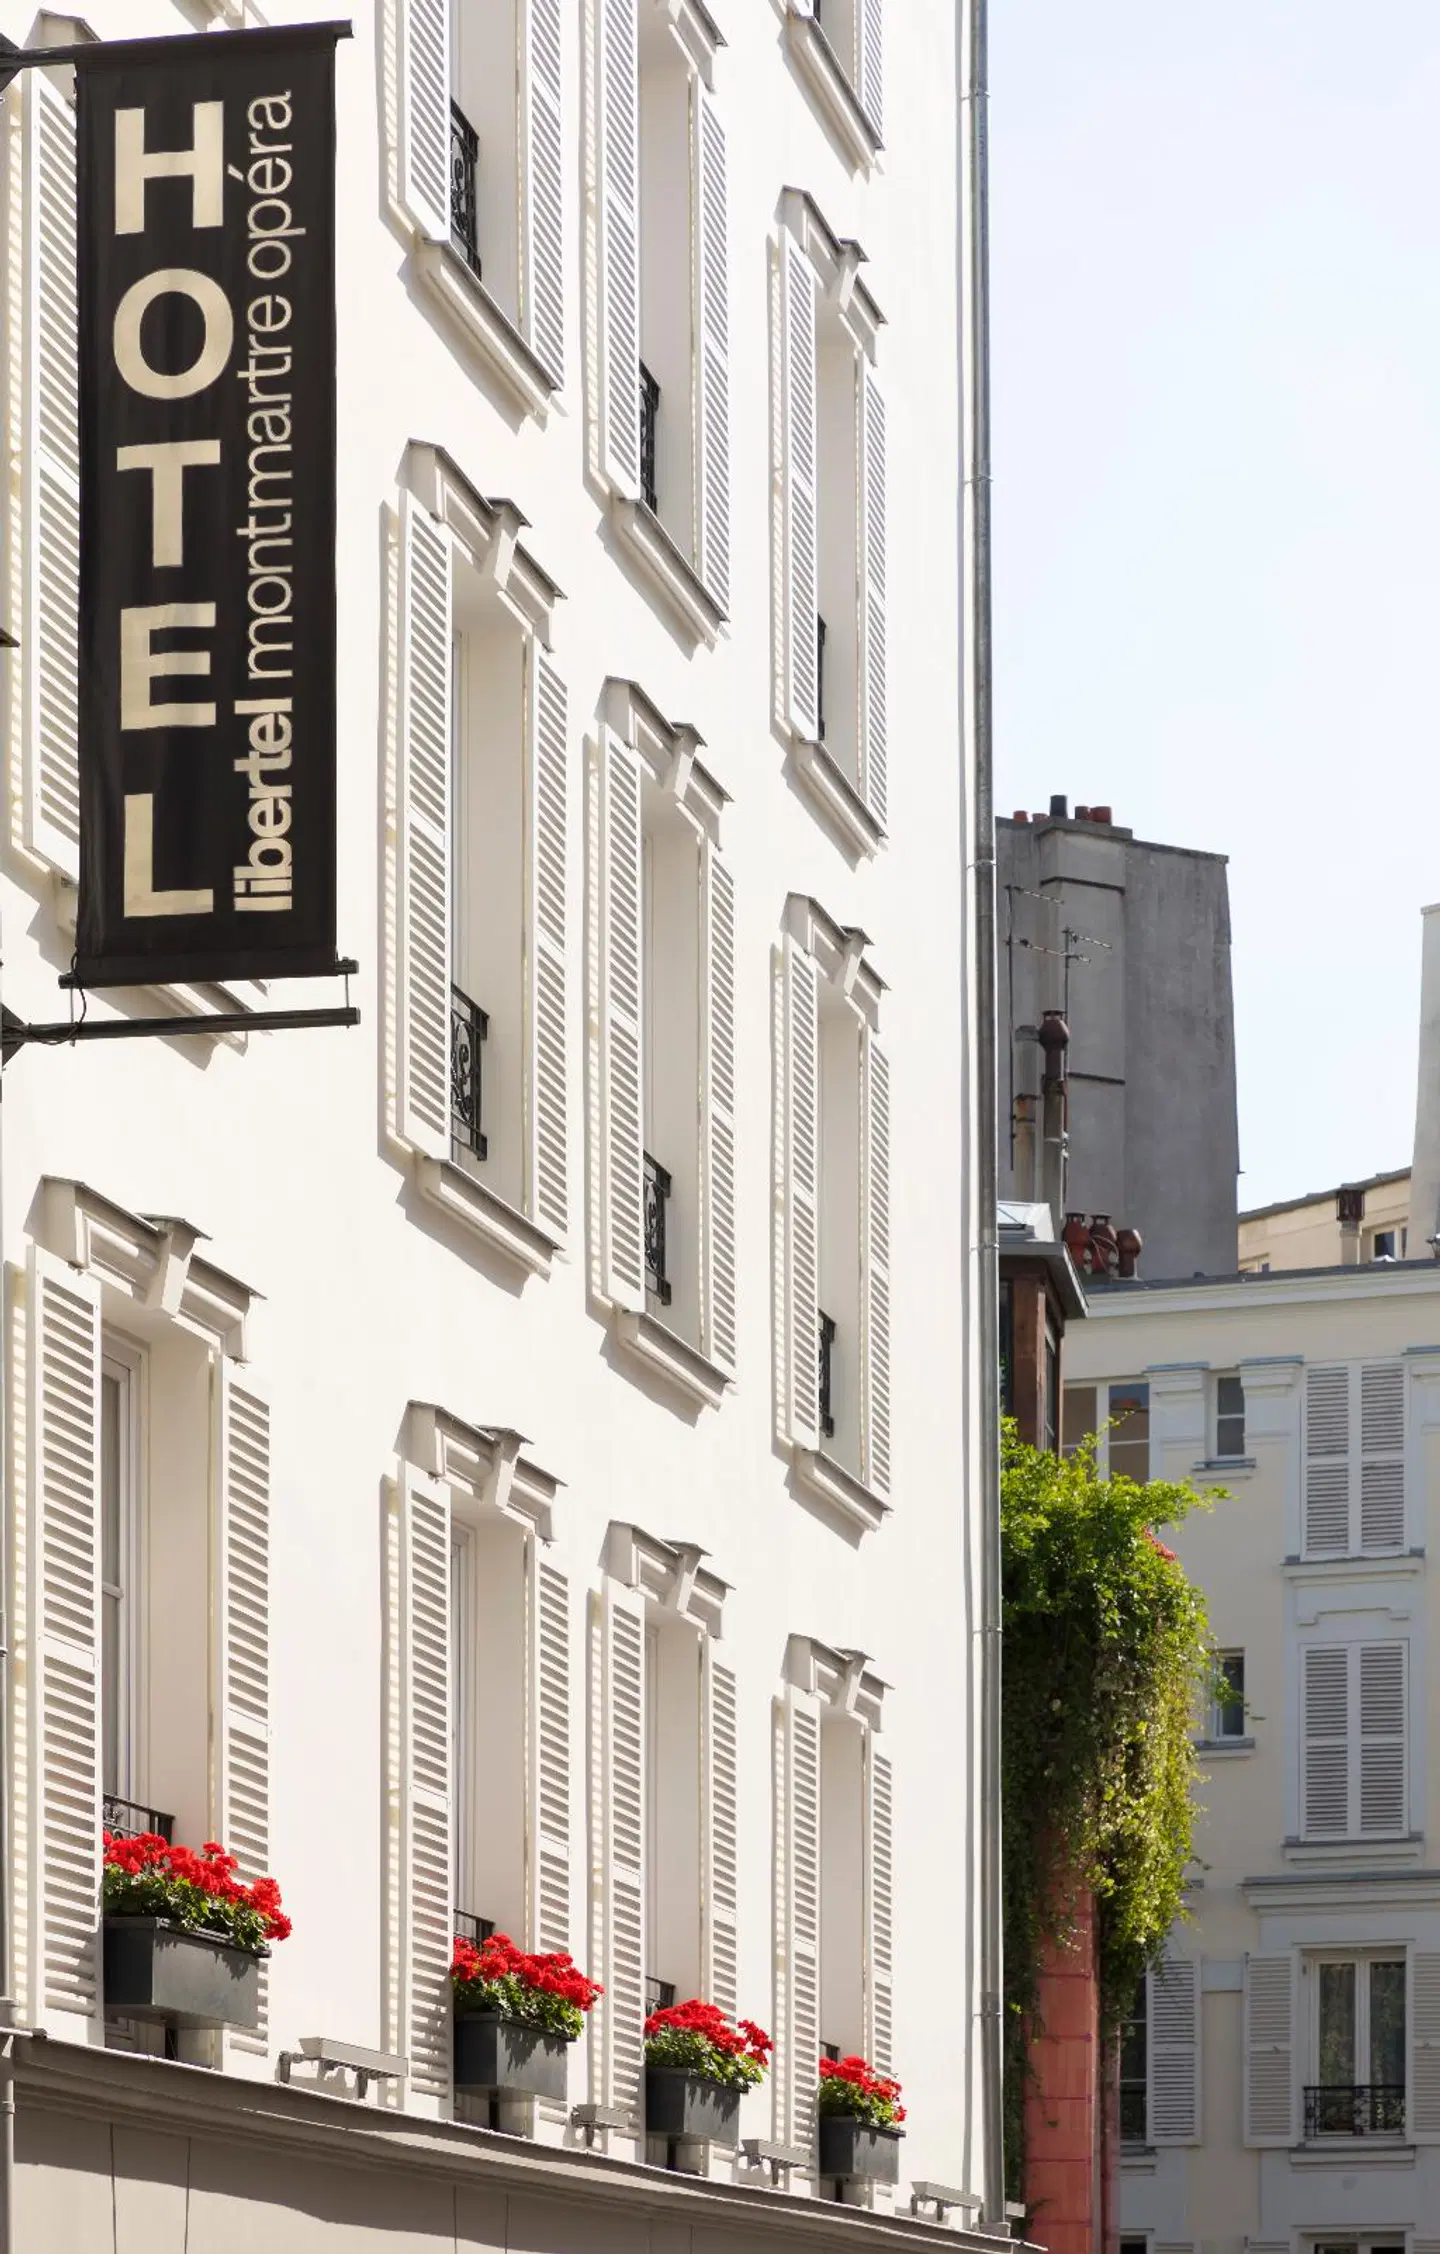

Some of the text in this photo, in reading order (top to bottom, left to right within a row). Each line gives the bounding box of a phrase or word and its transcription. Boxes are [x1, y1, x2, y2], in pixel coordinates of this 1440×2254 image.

[113, 101, 234, 917] HOTEL
[227, 91, 306, 911] libertel montmartre opéra
